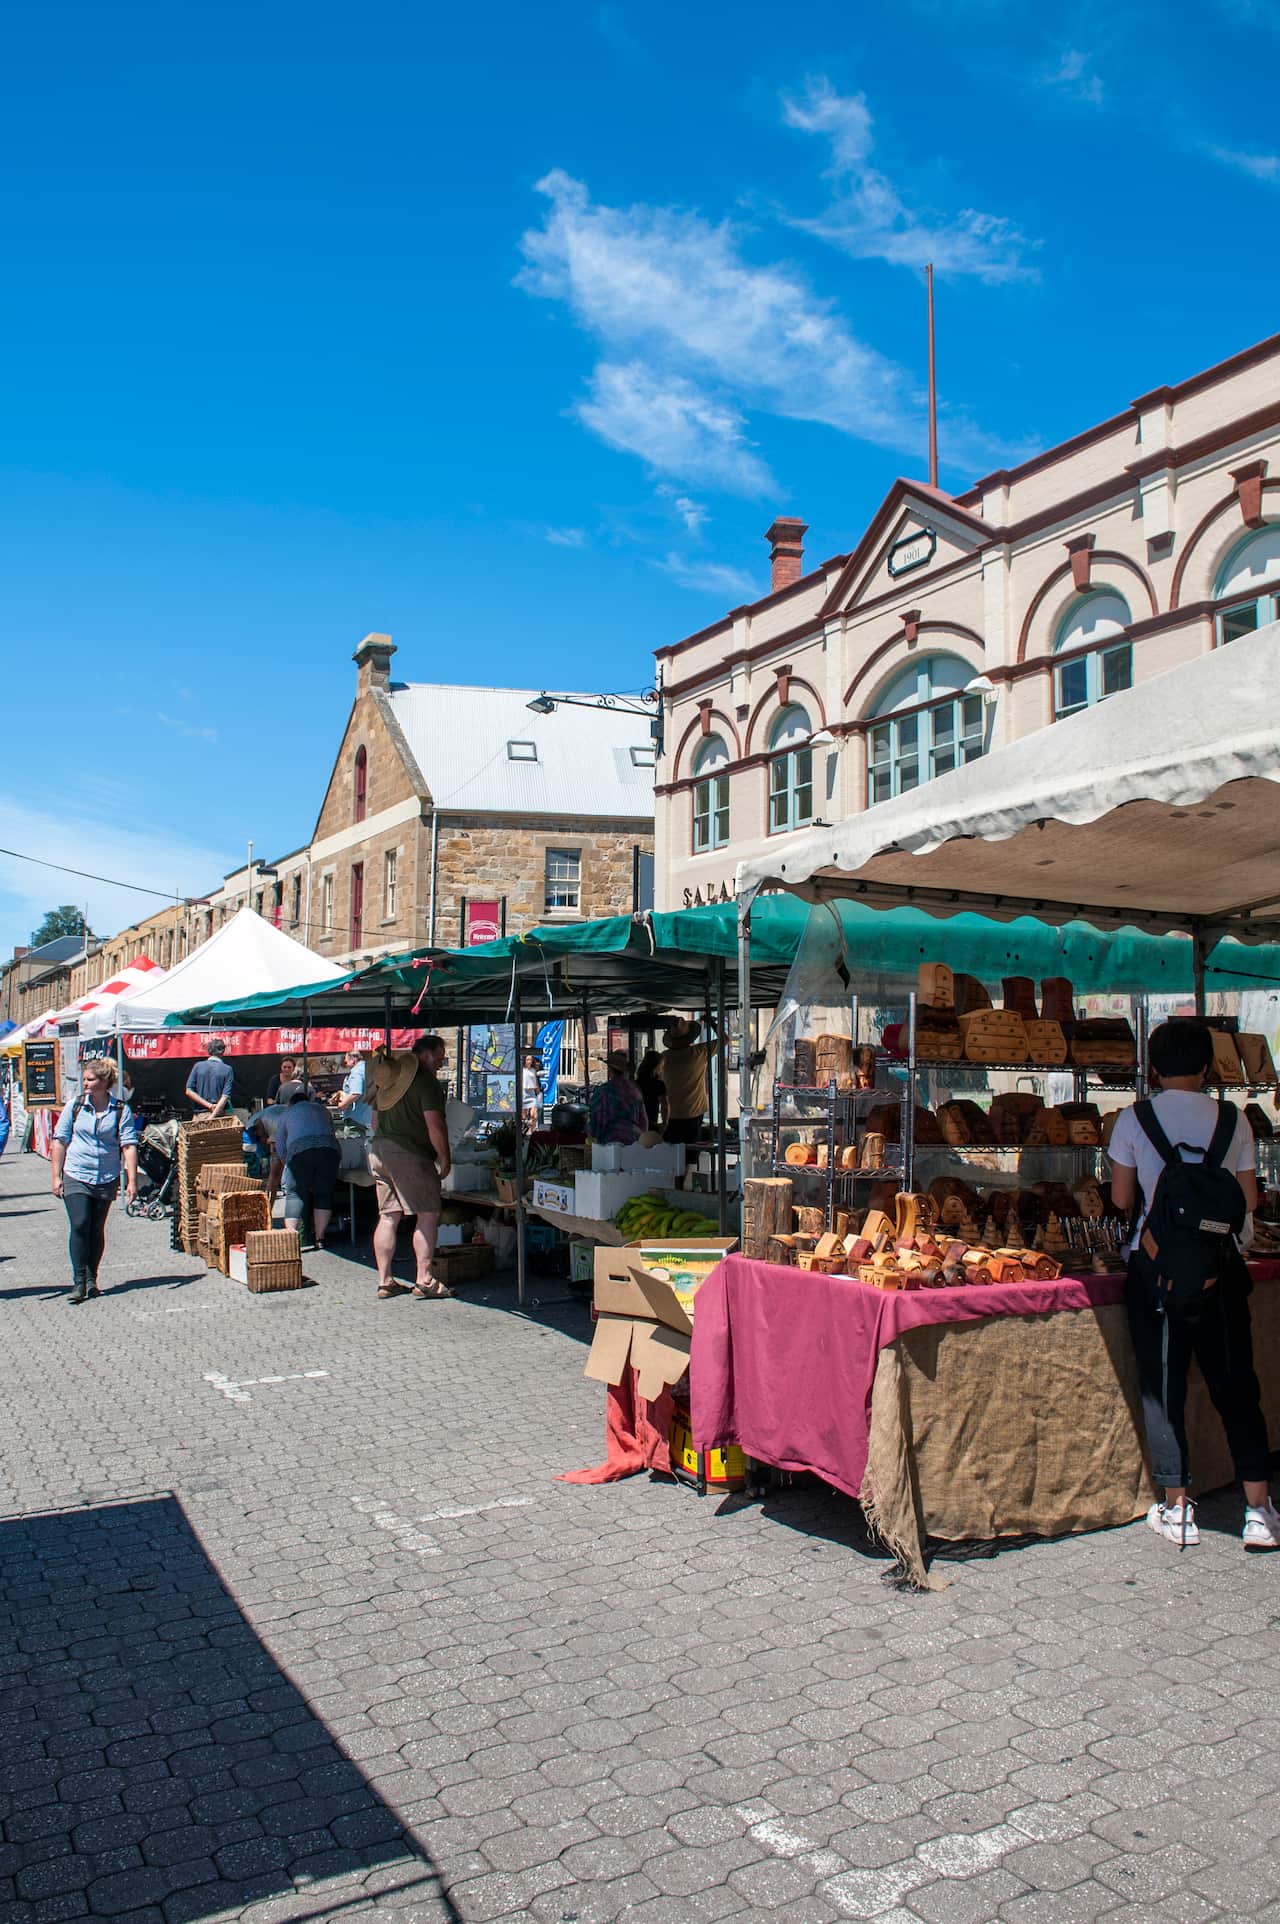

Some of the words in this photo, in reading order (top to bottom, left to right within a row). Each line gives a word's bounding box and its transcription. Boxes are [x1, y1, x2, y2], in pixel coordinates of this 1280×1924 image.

[903, 547, 920, 564] 1901
[128, 1047, 148, 1057] FARM
[540, 1047, 553, 1097] OILETS
